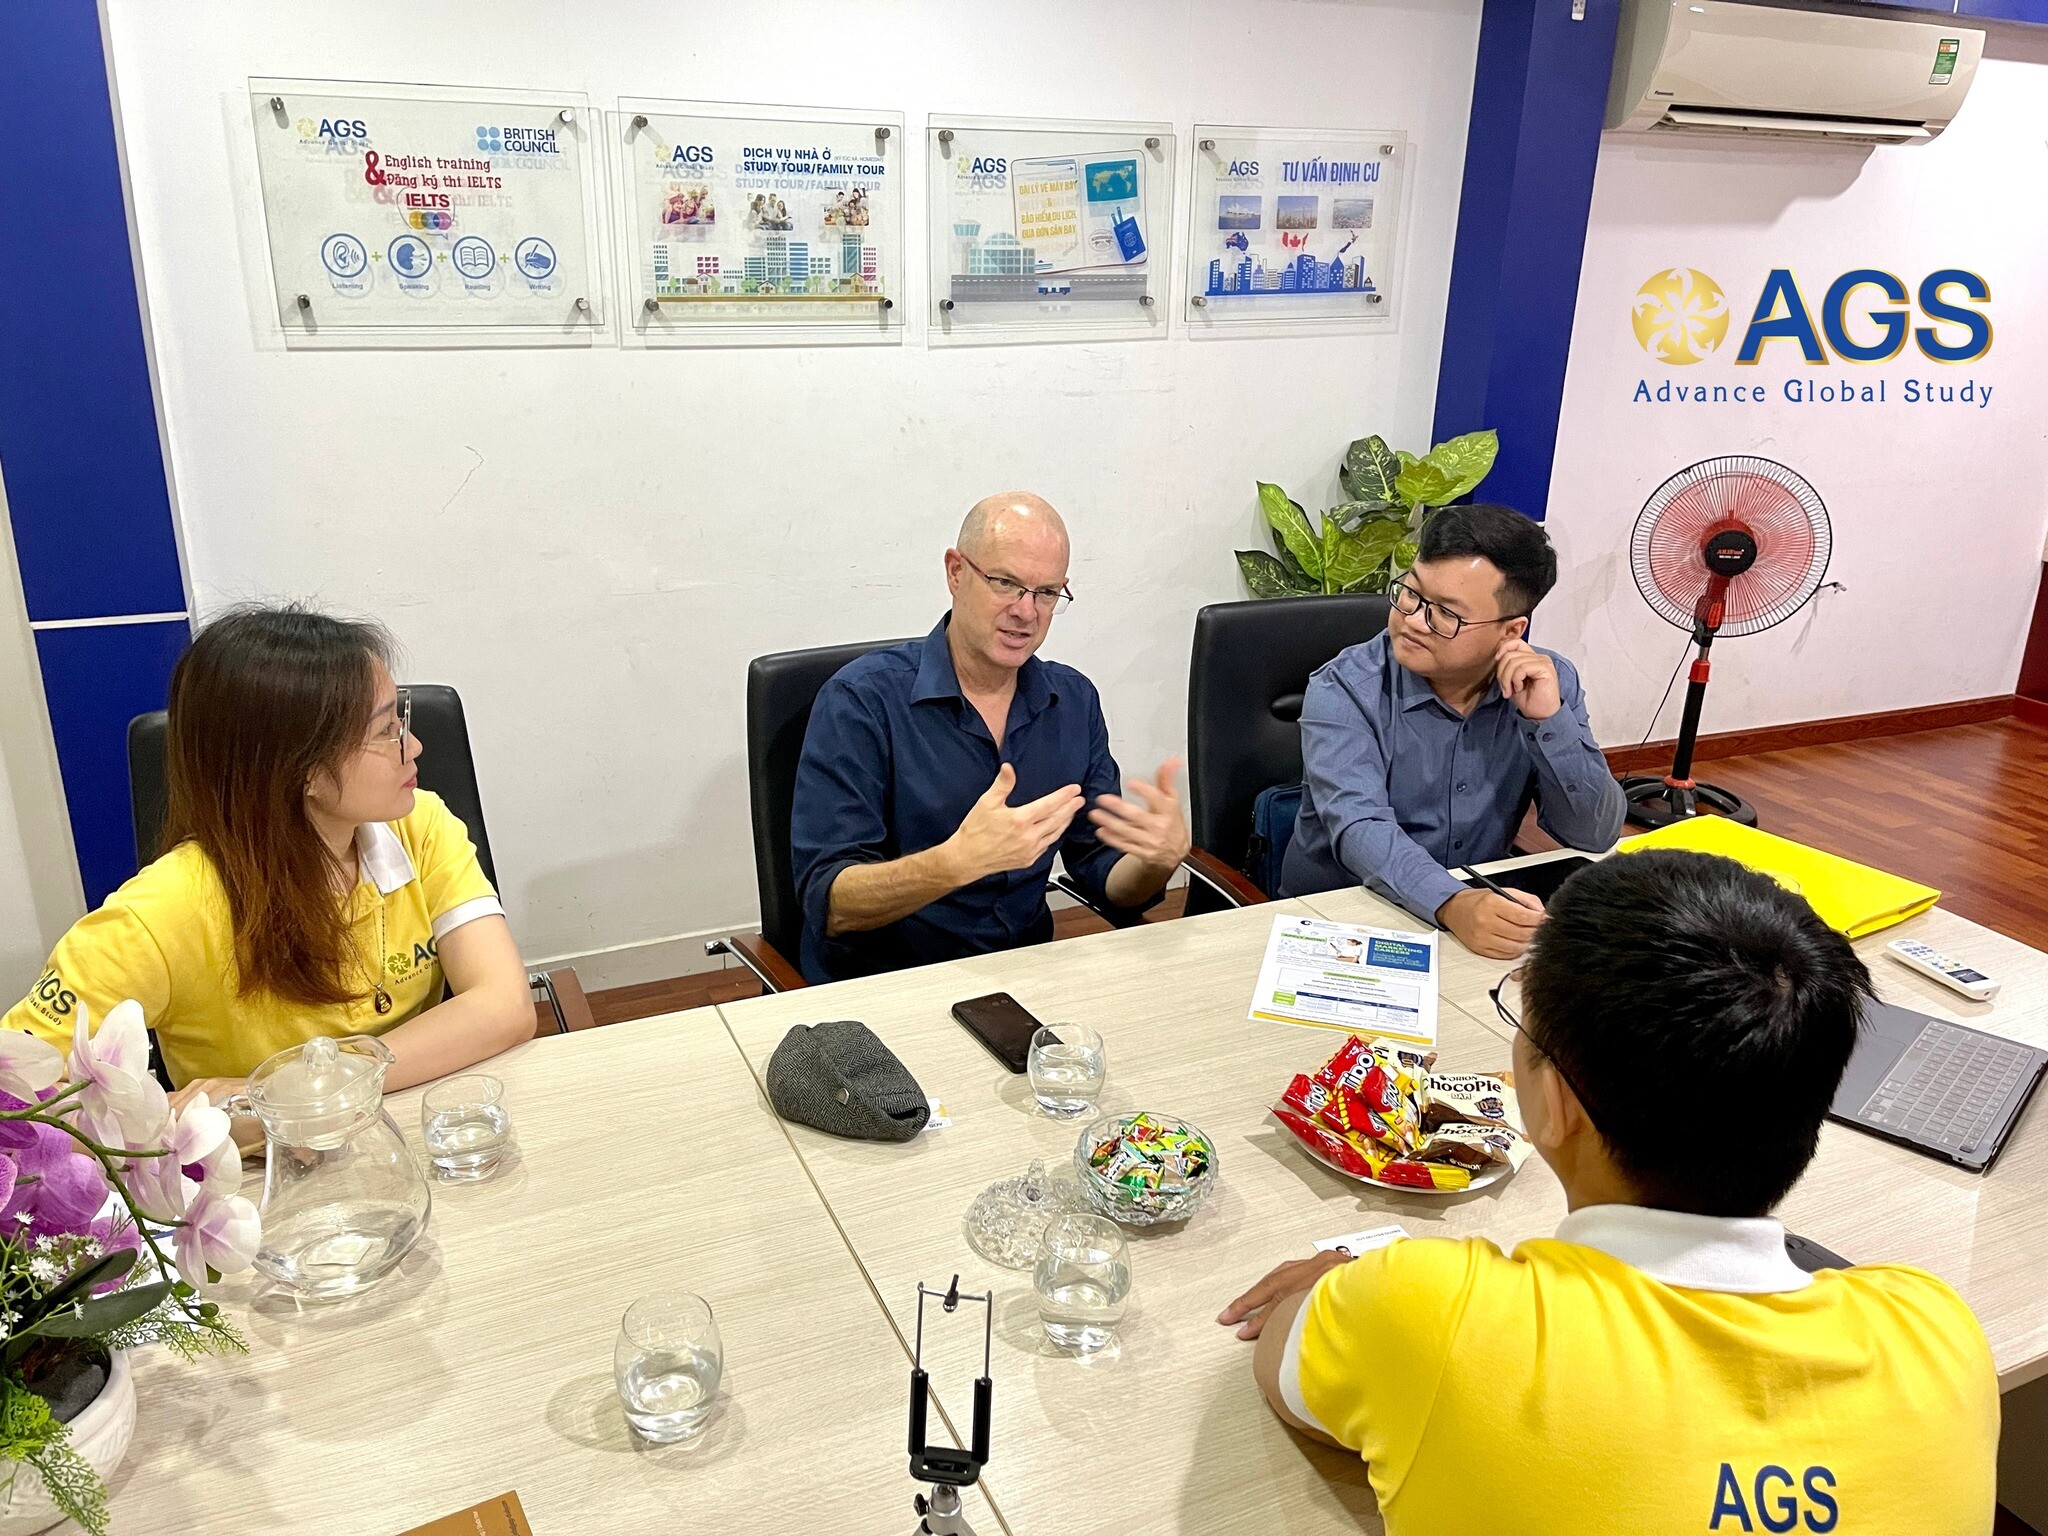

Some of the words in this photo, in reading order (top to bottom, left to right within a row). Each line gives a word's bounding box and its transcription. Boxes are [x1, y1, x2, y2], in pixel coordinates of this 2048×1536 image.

[318, 118, 368, 138] AGS
[503, 128, 556, 141] BRITISH
[504, 140, 560, 153] COUNCIL
[672, 144, 714, 163] AGS
[743, 147, 773, 161] DỊCH
[776, 148, 791, 162] VỤ
[794, 147, 819, 160] NHÀ
[365, 150, 387, 186] &
[384, 154, 432, 170] English
[436, 156, 491, 173] training
[743, 161, 778, 172] STUDY
[781, 162, 854, 175] TOUR/FAMILY
[857, 164, 885, 175] TOUR
[972, 157, 1006, 173] AGS
[1228, 160, 1260, 177] AGS
[1282, 161, 1300, 182] TƯ
[1302, 156, 1328, 182] VẤN
[1330, 161, 1360, 186] ĐỊNH
[1363, 161, 1381, 182] CƯ
[421, 171, 438, 190] ký
[442, 174, 461, 187] thi
[467, 176, 502, 189] IELTS
[405, 193, 450, 208] IELTS
[1064, 224, 1077, 235] BAY
[1374, 944, 1423, 954] MARKETING
[40, 1007, 63, 1026] Study
[1709, 1462, 1839, 1534] AGS
